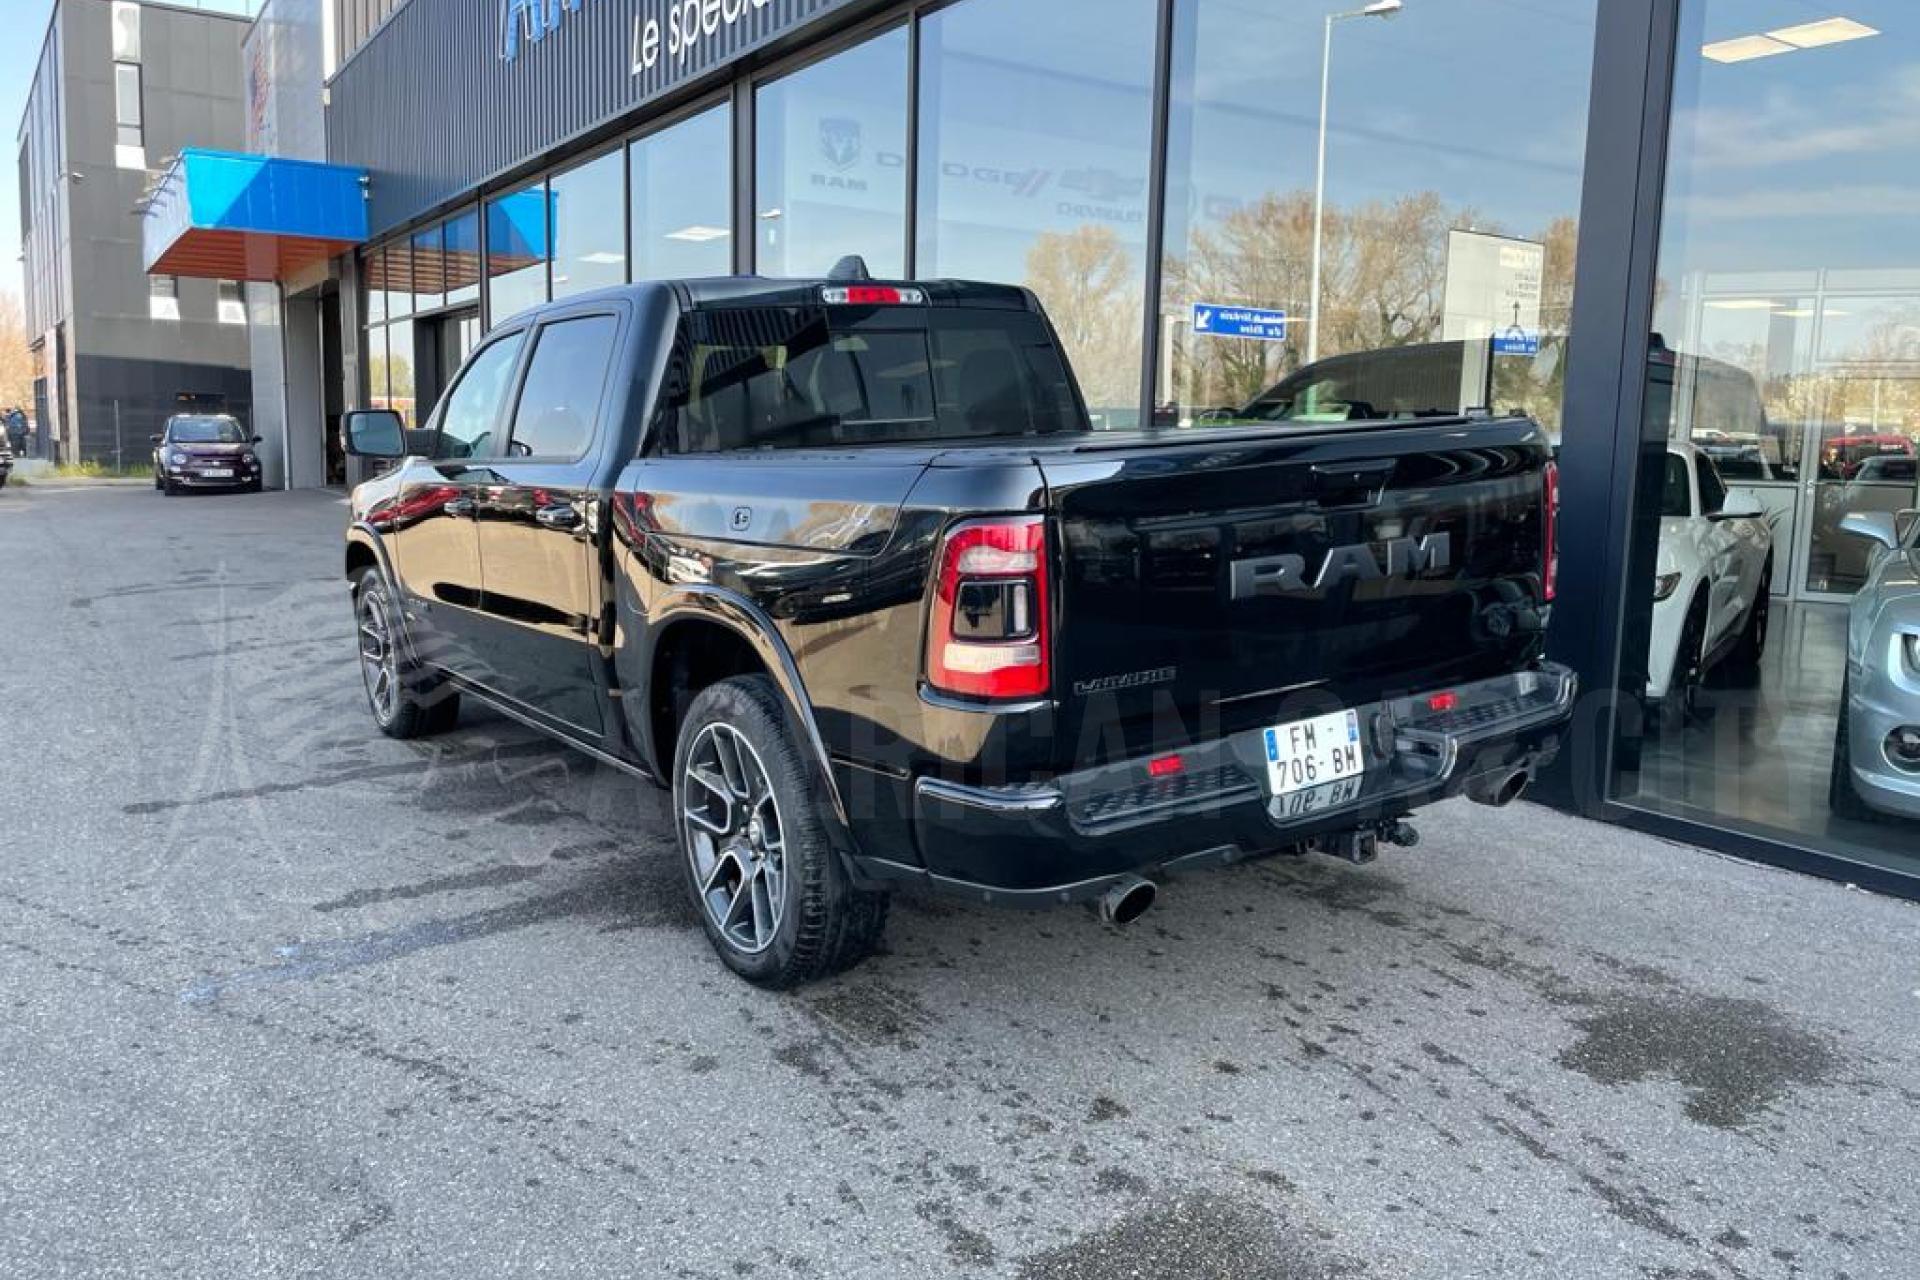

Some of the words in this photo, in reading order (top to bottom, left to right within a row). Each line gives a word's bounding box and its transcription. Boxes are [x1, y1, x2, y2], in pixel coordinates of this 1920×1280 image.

[631, 14, 659, 75] Le
[1229, 531, 1450, 601] RAM
[1289, 721, 1317, 755] FM
